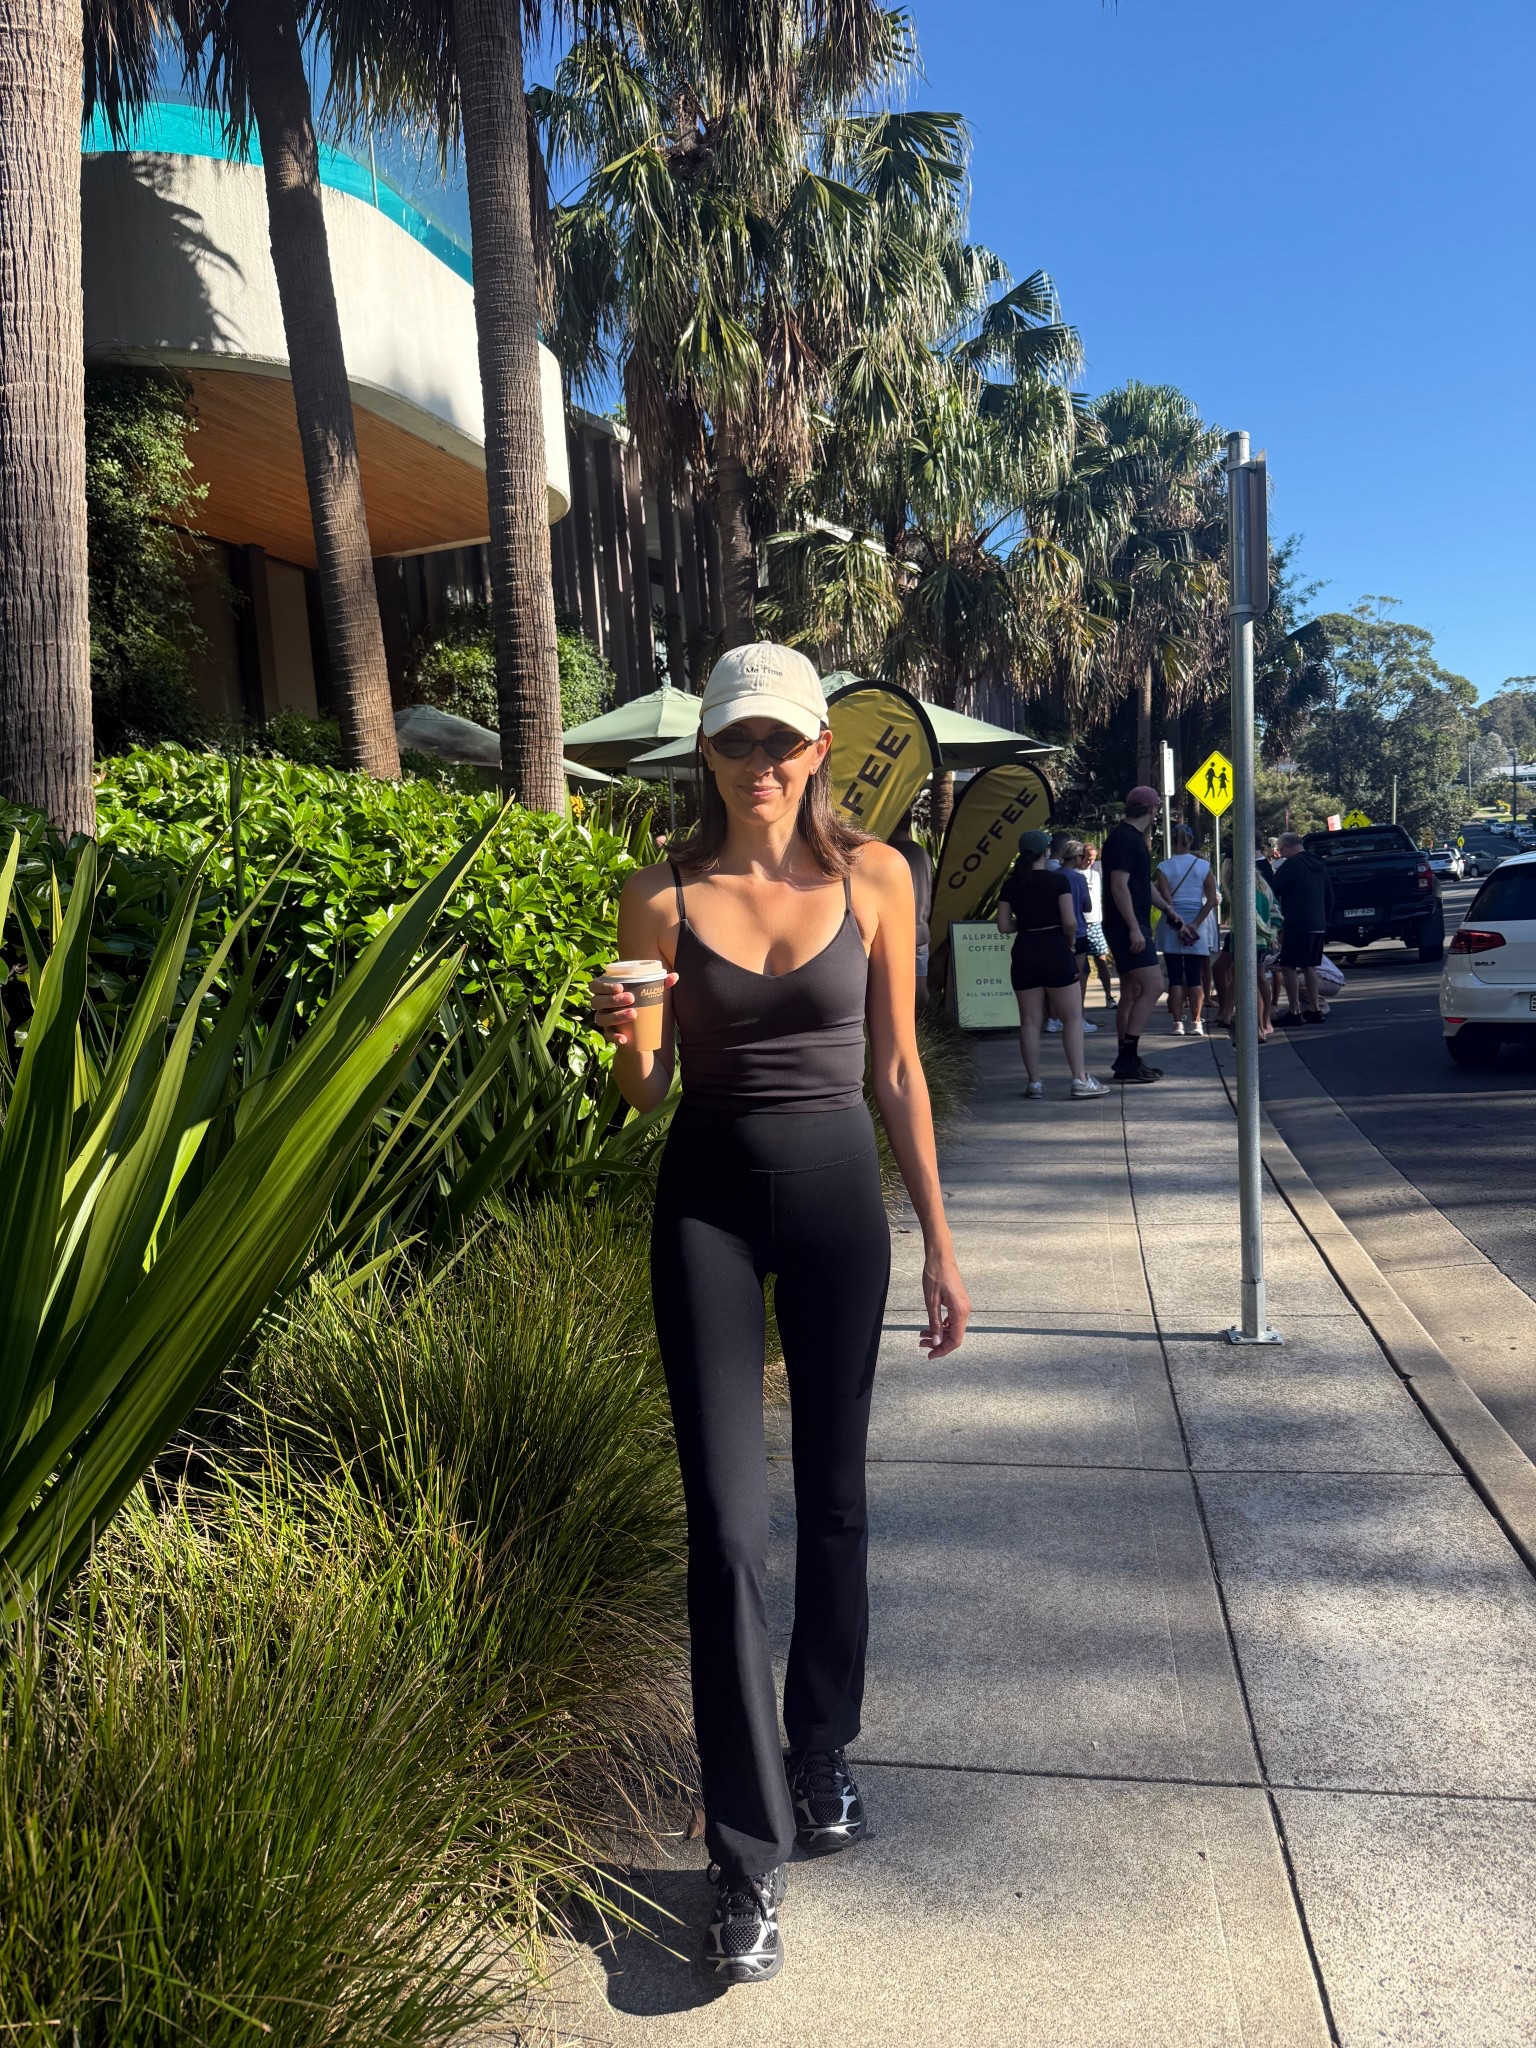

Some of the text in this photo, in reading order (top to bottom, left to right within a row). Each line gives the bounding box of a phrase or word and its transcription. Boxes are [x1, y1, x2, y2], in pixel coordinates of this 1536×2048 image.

[760, 666, 783, 677] Time
[837, 725, 912, 817] FEE
[948, 787, 1039, 890] COFFEE
[961, 933, 1011, 941] ALLPRESS
[968, 944, 1006, 952] COFFEE
[975, 978, 1003, 986] OPEN
